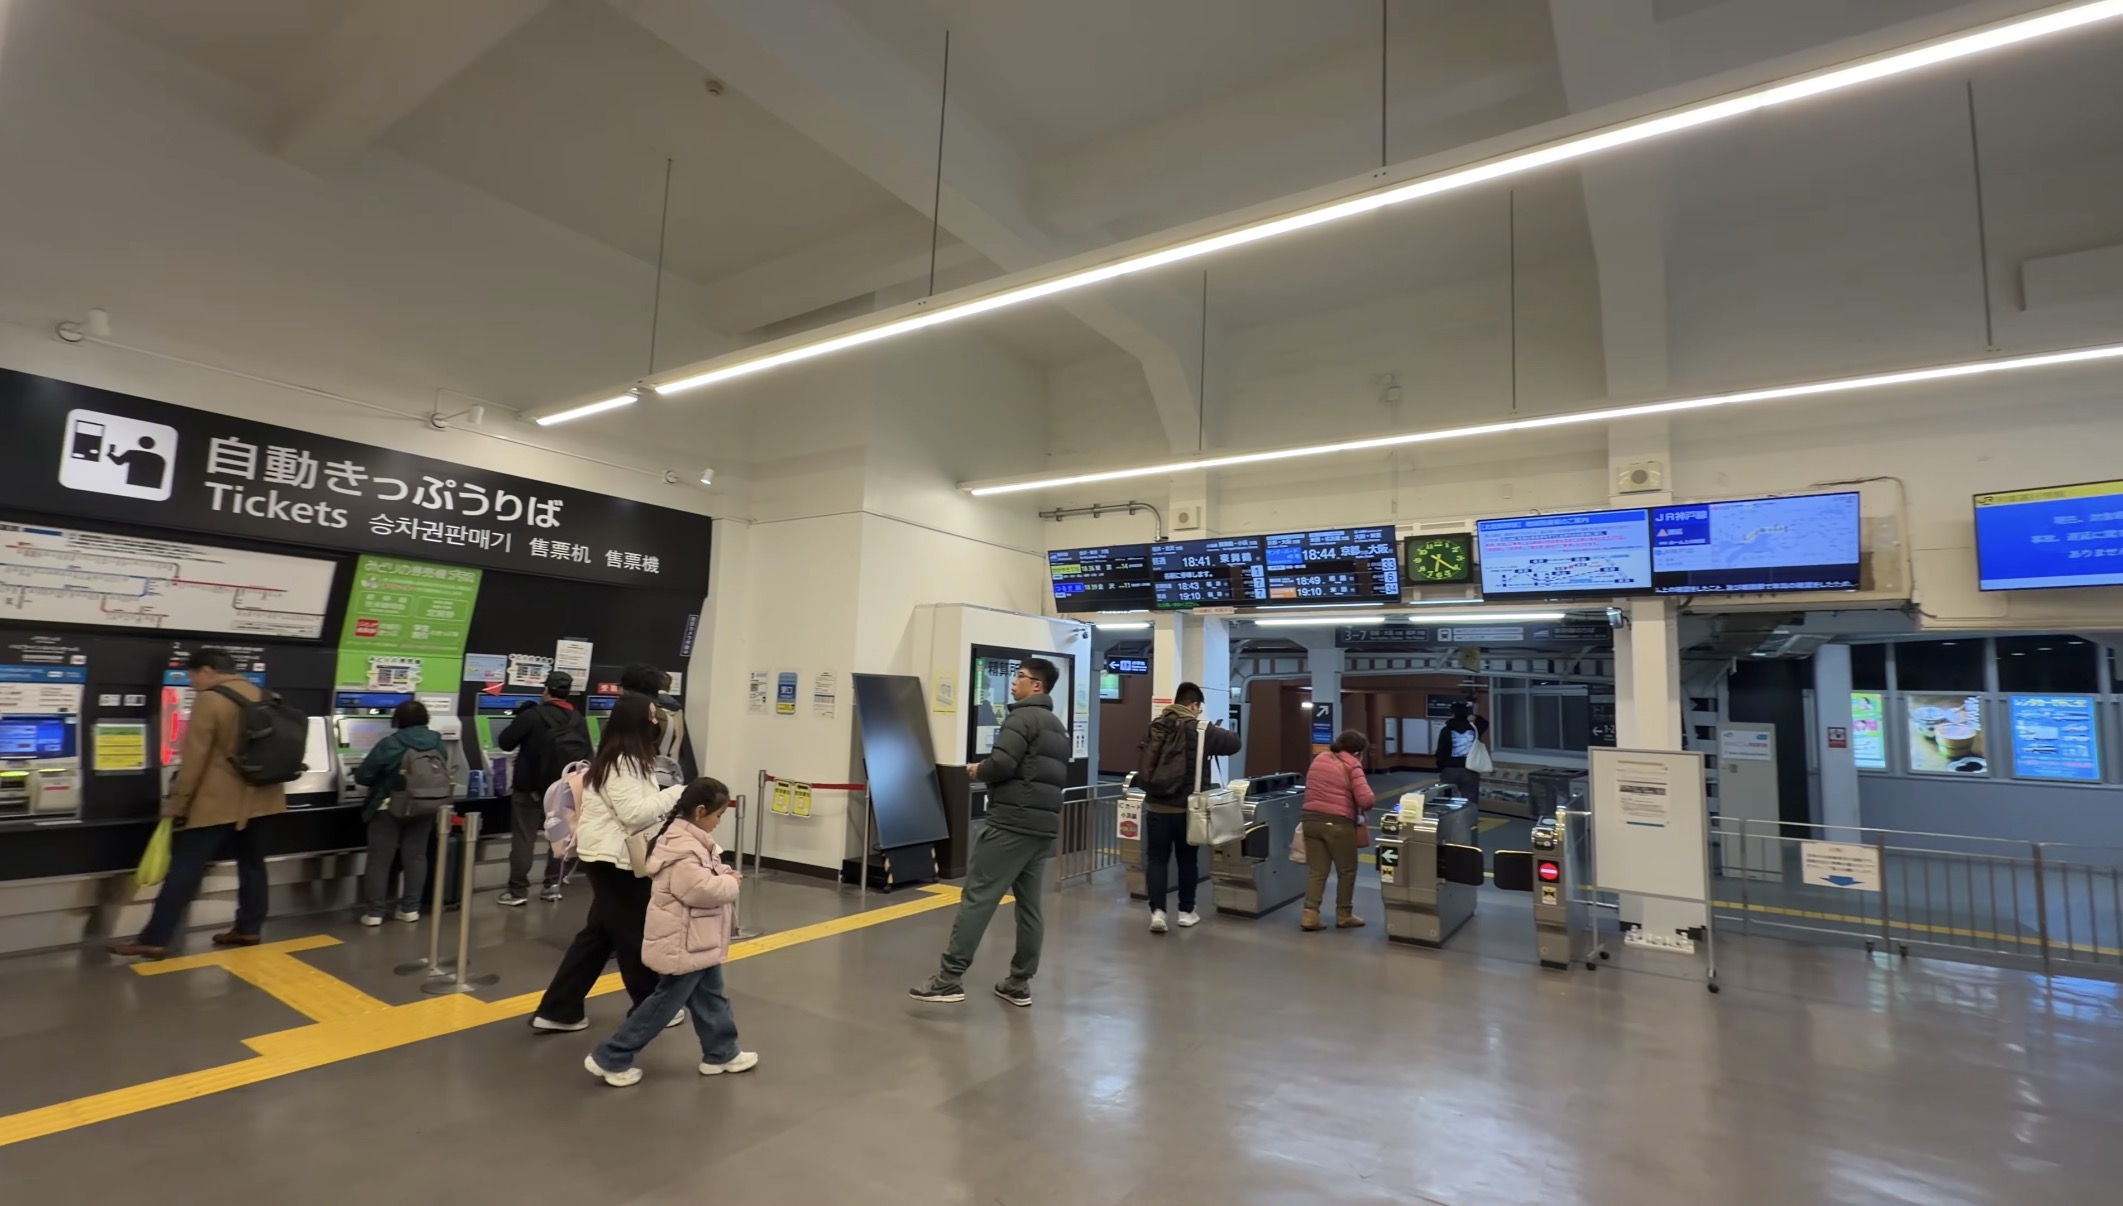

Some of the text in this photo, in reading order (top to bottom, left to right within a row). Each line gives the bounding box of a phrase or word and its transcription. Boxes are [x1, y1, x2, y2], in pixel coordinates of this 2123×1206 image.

[208, 437, 564, 527] 自動きっぷうりば
[205, 482, 348, 529] Tickets
[369, 514, 513, 553] 승차권판매기
[528, 537, 660, 575] 售票机 售票機
[1302, 548, 1336, 560] 18:44
[1182, 556, 1211, 567] 18:41
[1178, 582, 1200, 590] 18:43
[1296, 576, 1321, 585] 18:49
[1179, 592, 1201, 601] 19:10
[1297, 588, 1322, 596] 19:10
[988, 661, 1019, 678] 精算所
